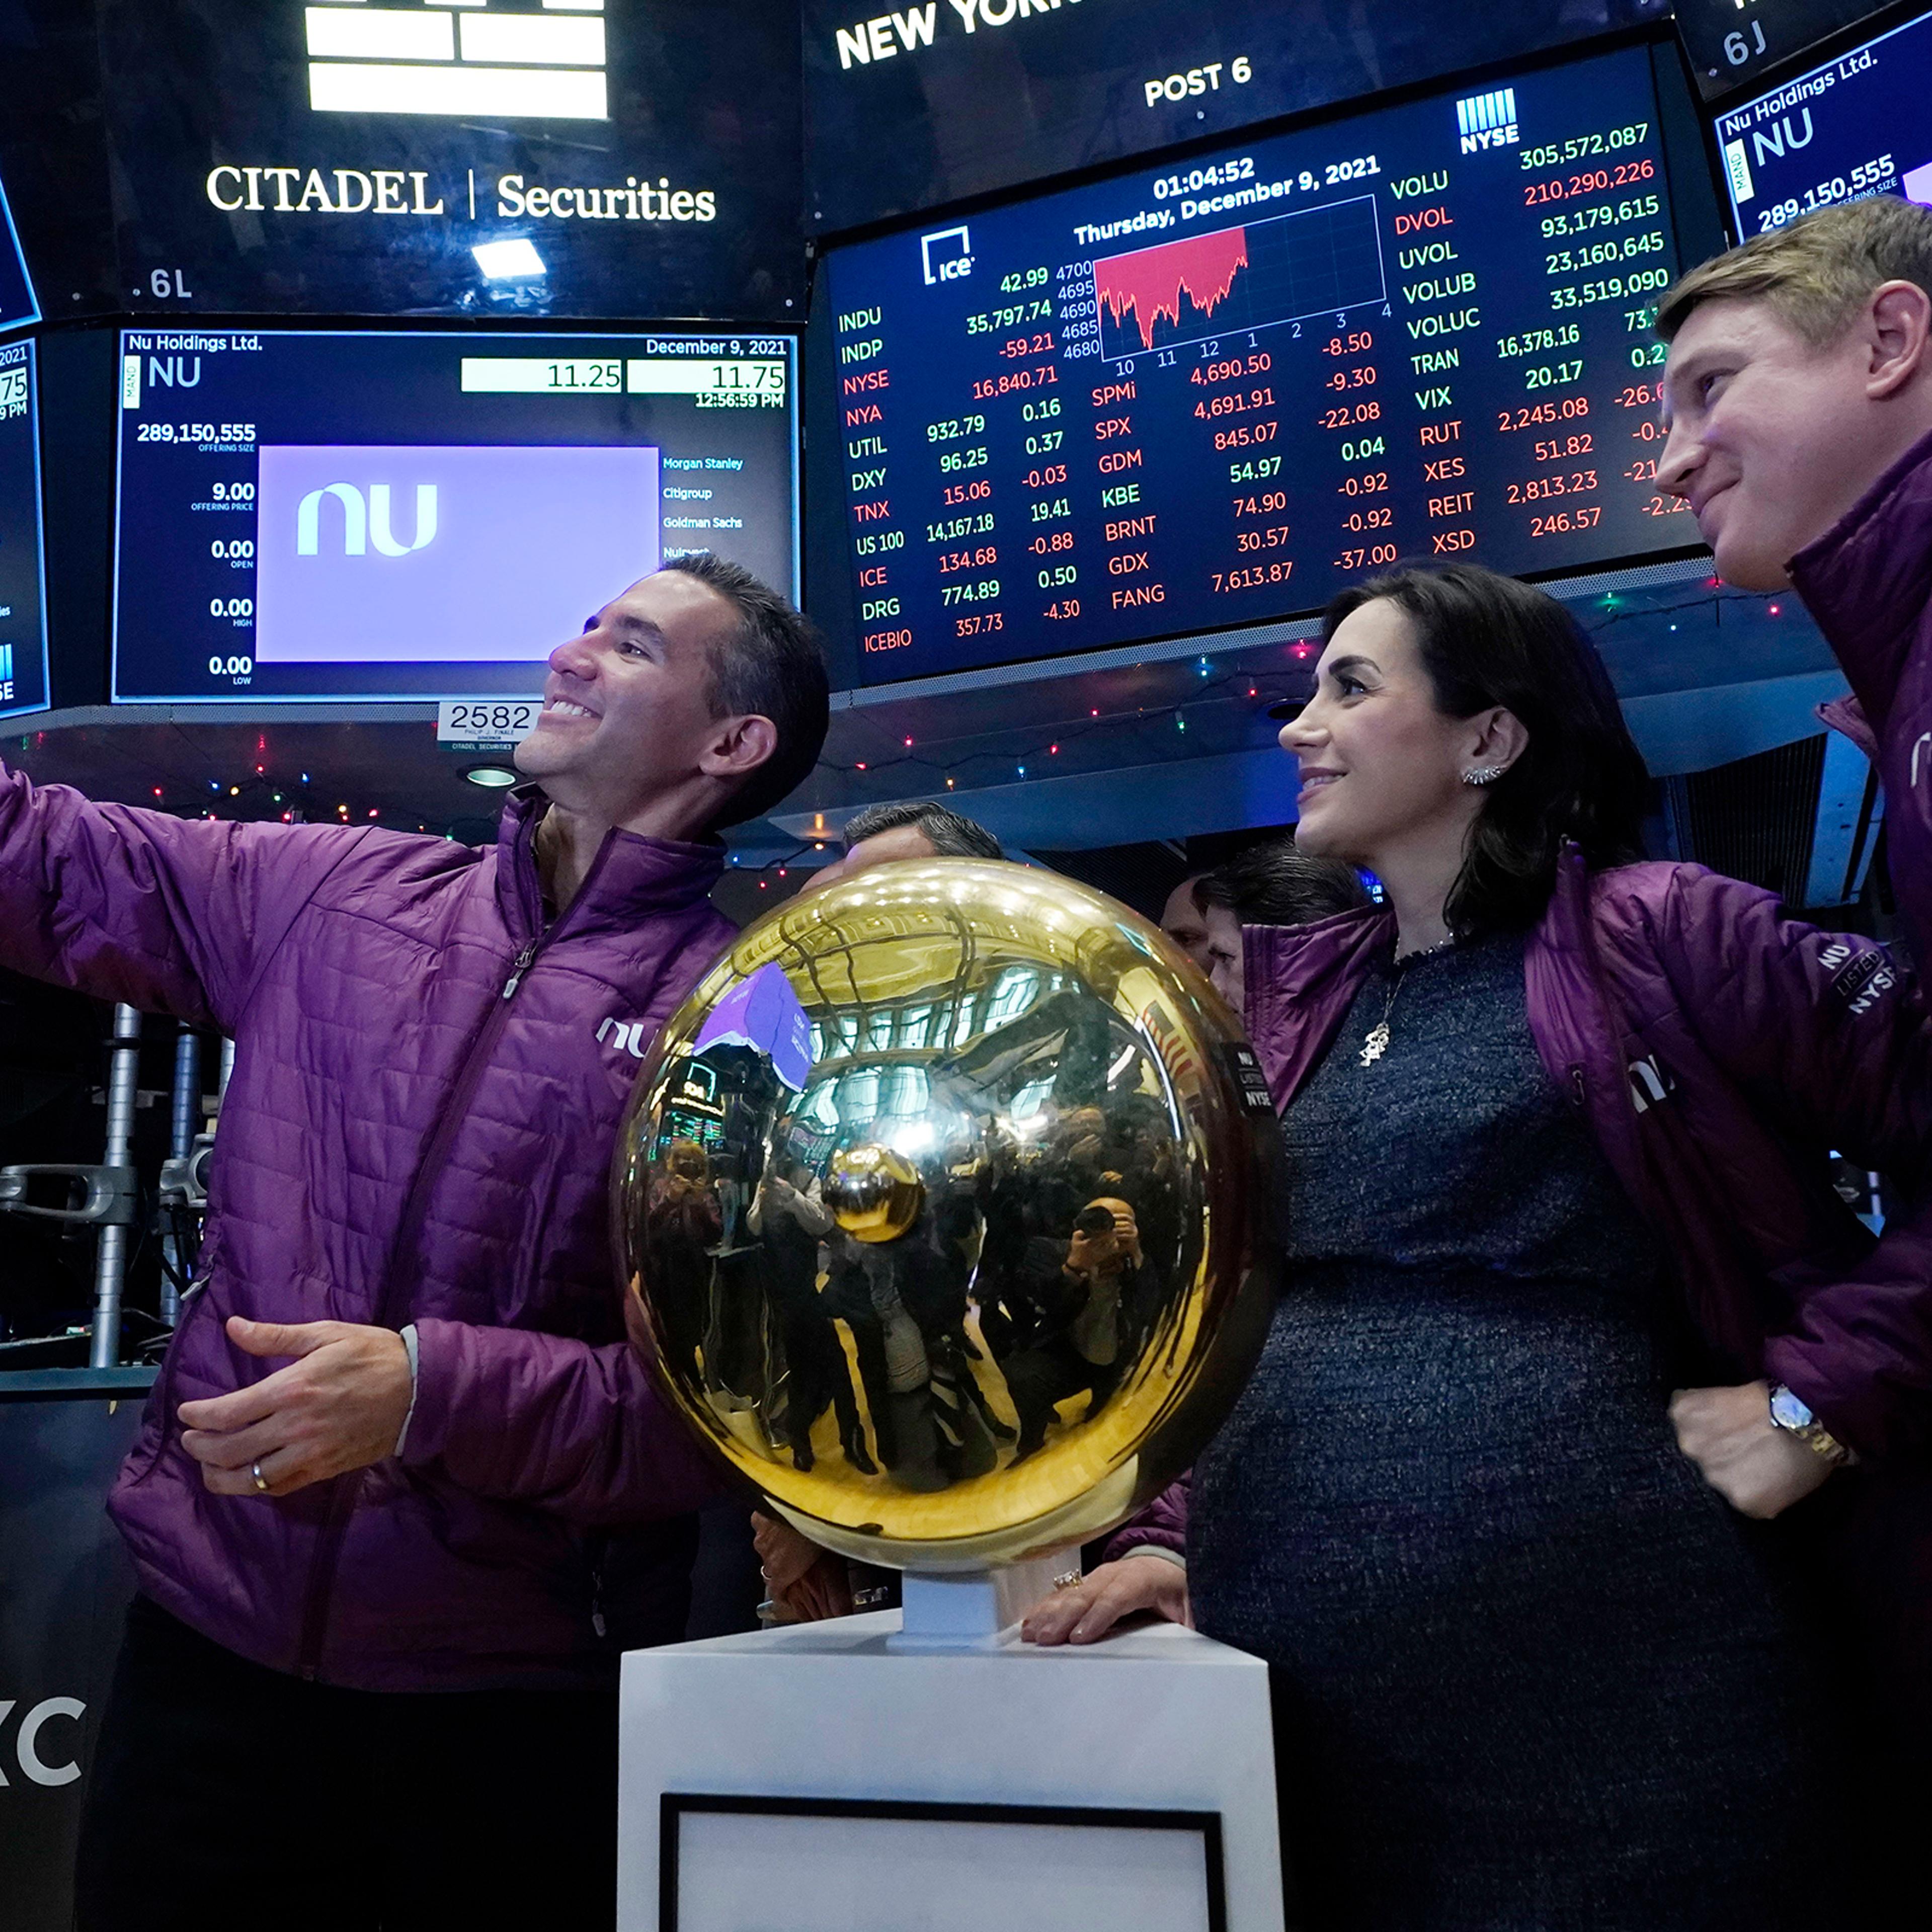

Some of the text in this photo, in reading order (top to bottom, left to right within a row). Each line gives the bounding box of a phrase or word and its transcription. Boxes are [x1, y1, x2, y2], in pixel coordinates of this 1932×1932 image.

[836, 2, 936, 69] NEW
[1724, 20, 1766, 65] 6J
[1144, 56, 1252, 107] POST 6
[1725, 49, 1878, 136] Nu Holdings Ltd.
[1461, 124, 1520, 154] NYSE
[1752, 107, 1813, 167] NU
[1153, 157, 1255, 200] 01:04:52
[1390, 123, 1648, 200] VOLU 305,572,087
[1731, 152, 1742, 190] MAND
[1877, 177, 1897, 193] SIZE
[206, 166, 716, 221] CITADEL Securities
[1073, 155, 1381, 245] Thursday, December 9, 2021
[1395, 159, 1654, 235] DVOL 210,290,226
[1758, 153, 1895, 232] 289,150,555
[1399, 195, 1659, 270] UVOL 93,179,615
[150, 269, 192, 298] 6L
[1056, 260, 1092, 280] 4700
[1058, 280, 1094, 300] 4695
[1402, 231, 1664, 304] VOLUB 23,160,645
[839, 267, 1049, 333] INDU 42.99
[1060, 300, 1096, 320] 4690
[1407, 268, 1668, 339] VOLUC 33,519,090
[129, 335, 263, 353] Nu Holdings Ltd.
[647, 339, 787, 356] December 9, 2021
[841, 299, 1052, 364] INDP 35,797.74
[1062, 319, 1098, 340] 4685
[1064, 339, 1100, 359] 4680
[1116, 303, 1392, 376] 10 11 12 1 2 3 4
[1410, 324, 1580, 375] TRAN 16,378.16
[126, 365, 136, 397] MAND
[149, 356, 201, 387] NU
[548, 365, 620, 387] 11.25
[712, 367, 784, 388] 11.75
[844, 333, 1055, 395] NYSE -59.21
[1092, 332, 1372, 407] SPMi 4,690.50 -8.50
[1415, 360, 1583, 410] VIX 20.17
[9, 401, 27, 418] PM
[695, 394, 783, 408] 12:56:59 PM
[846, 365, 1058, 427] NYA 16,840.71
[1095, 366, 1376, 440] SPX 4,691.91 -9.30
[137, 424, 256, 444] 289,150,555
[849, 398, 1061, 459] UTIL 932.79 0.16
[1098, 401, 1381, 473] GDM 845.07 -22.08
[1420, 397, 1589, 446] RUT 2,245.08
[199, 444, 255, 452] OFFERING SIZE
[663, 457, 743, 471] Morgan Stanley
[852, 431, 1063, 492] DXY 96.25 0.37
[1424, 434, 1593, 482] XES 51.82
[212, 482, 255, 501] 9.00
[663, 487, 712, 501] Citigroup
[853, 464, 1067, 522] TNX 15.06 -0.03
[1102, 436, 1385, 508] KBE 54.97 0.04
[1428, 470, 1598, 517] REIT 2,813.23
[191, 502, 253, 511] OFFERING PRICE
[297, 482, 437, 556] nu
[663, 516, 743, 528] Goldman Sachs
[857, 498, 1071, 555] US 100 14,167.18 19.41
[1105, 472, 1388, 541] BRNT 74.90 -0.92
[211, 540, 254, 558] 0.00
[1109, 508, 1393, 575] GDX 30.57 -0.92
[1432, 507, 1601, 554] XSD 246.57
[230, 560, 254, 569] OPEN
[860, 532, 1074, 587] ICE 134.68 -0.88
[1112, 544, 1397, 609] FANG 7,613.87 -37.00
[210, 598, 253, 617] 0.00
[862, 566, 1077, 620] DRG 774.89 0.50
[232, 619, 253, 627] HIGH
[865, 599, 1080, 653] ICEBIO 357.73 -4.30
[209, 656, 252, 675] 0.00
[233, 677, 252, 685] LOW
[451, 706, 530, 729] 2582
[1818, 945, 1850, 970] NU
[1837, 950, 1880, 996] LISTED
